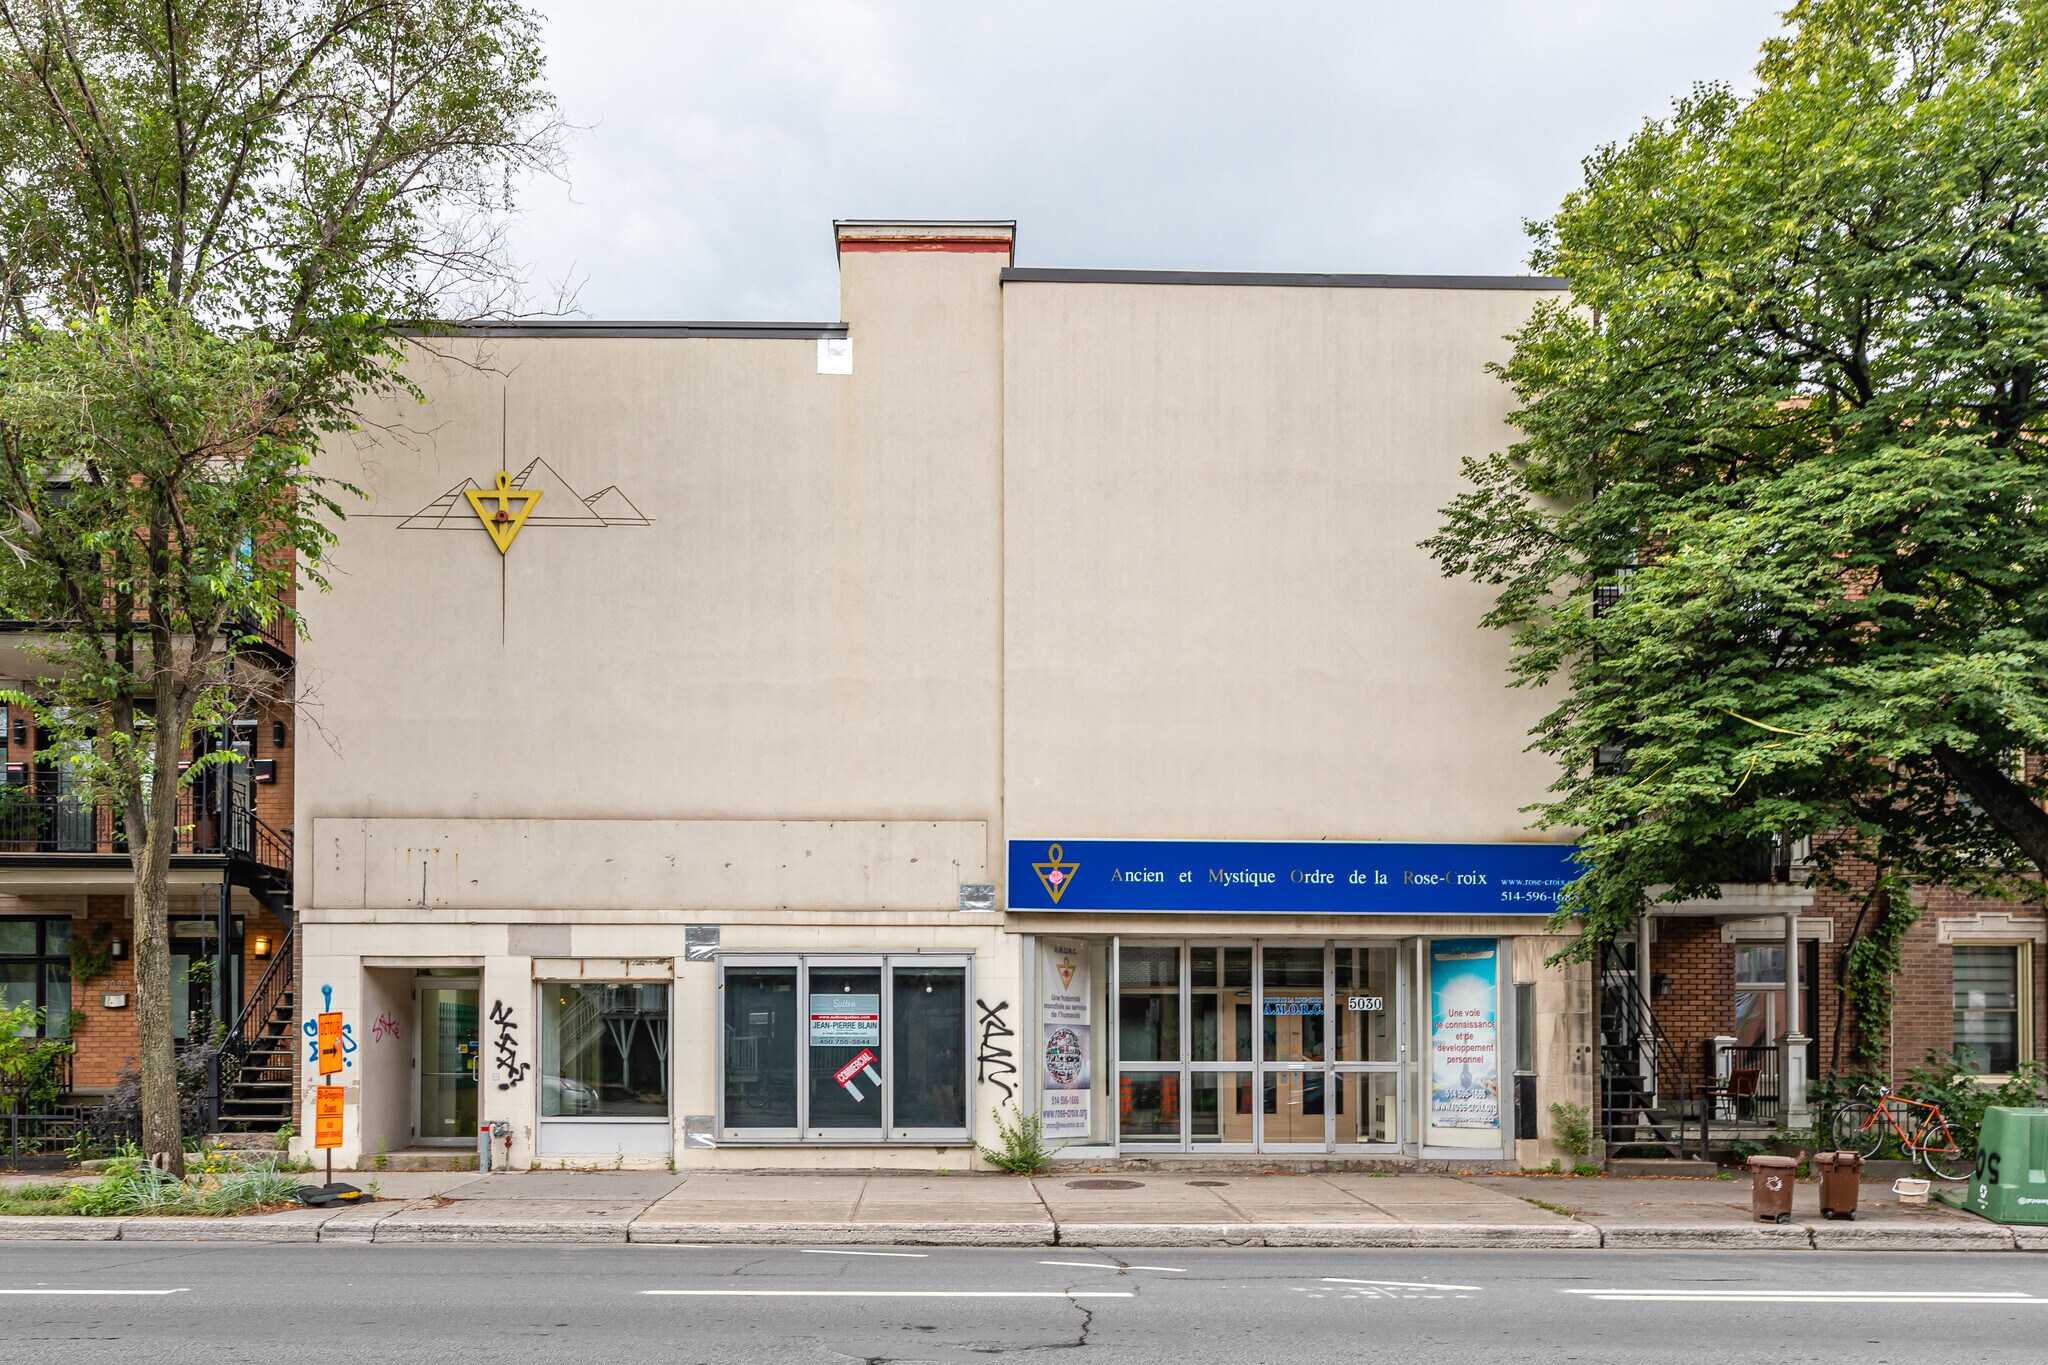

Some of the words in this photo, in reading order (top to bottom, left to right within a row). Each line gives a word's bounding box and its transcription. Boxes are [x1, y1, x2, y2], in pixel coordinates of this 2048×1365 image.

[1111, 867, 1164, 883] Ancien
[1179, 870, 1192, 883] et
[1208, 868, 1276, 887] Mystique
[1290, 869, 1335, 884] Ordre
[1349, 870, 1367, 885] de
[1375, 870, 1388, 885] la
[1403, 870, 1487, 885] Rose-Croix
[1050, 993, 1060, 1001] Une
[1349, 998, 1383, 1010] 5030
[1448, 1008, 1463, 1018] Une
[1464, 1008, 1481, 1017] voie
[813, 1021, 856, 1029] JEAN-PIERRE
[857, 1021, 878, 1029] BLAIN
[1434, 1021, 1444, 1029] de
[1445, 1020, 1496, 1029] connaissance
[1455, 1032, 1463, 1041] et
[1463, 1032, 1474, 1041] de
[1437, 1043, 1494, 1054] développement
[1446, 1055, 1484, 1066] personnel
[836, 1052, 872, 1083] COMMERCIAL
